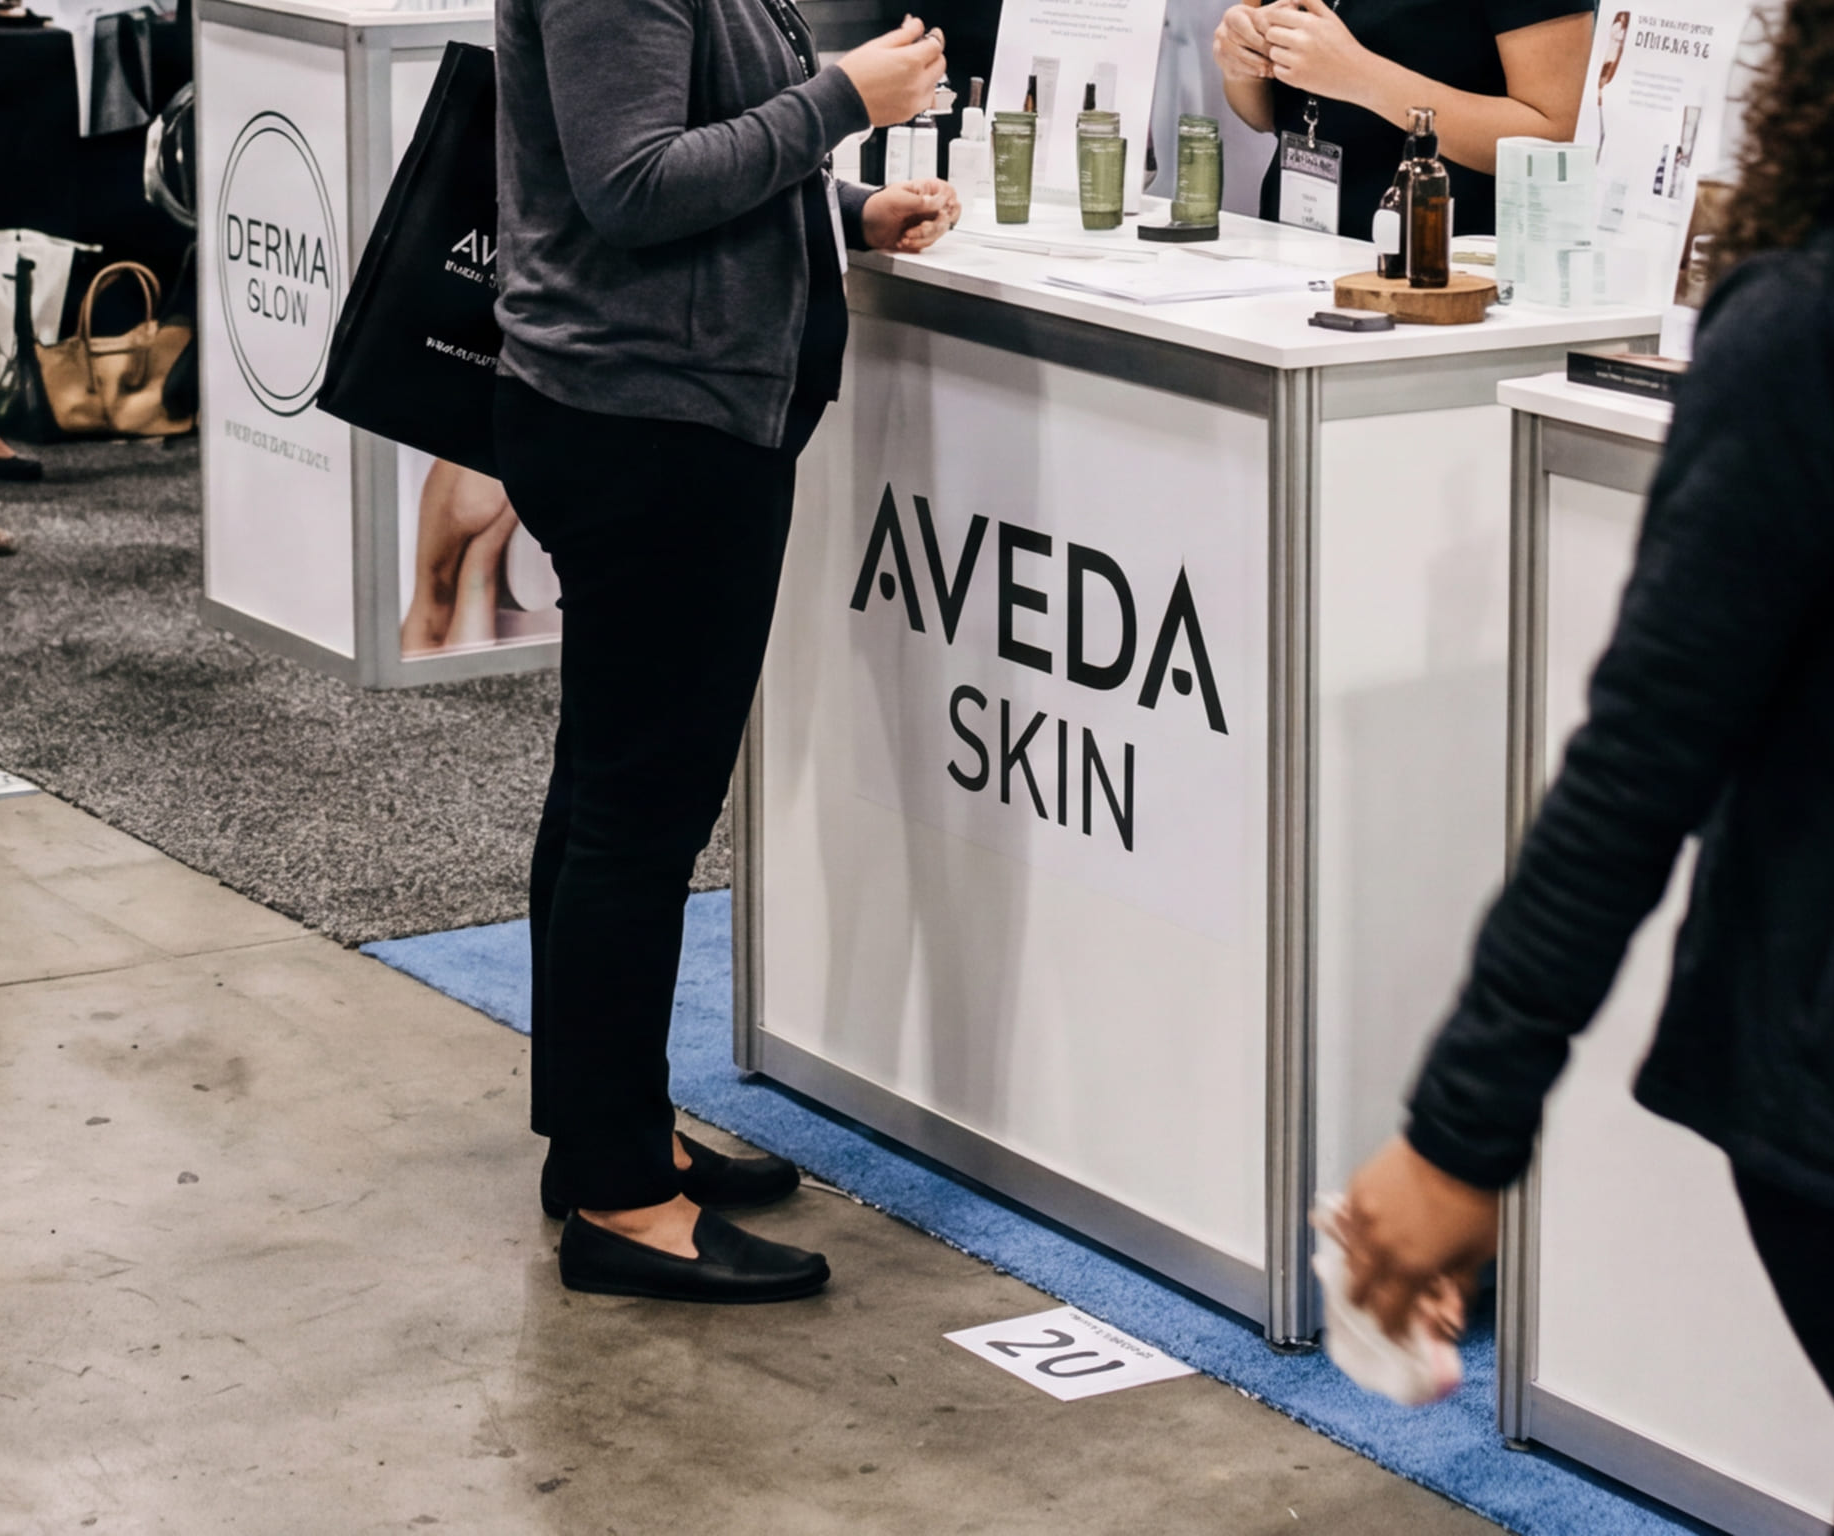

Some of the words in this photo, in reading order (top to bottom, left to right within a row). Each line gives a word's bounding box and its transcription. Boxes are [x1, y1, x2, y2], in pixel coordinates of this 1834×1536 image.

[227, 213, 330, 290] DERMA
[849, 481, 1230, 736] AVEDA
[946, 683, 1135, 853] SKIN
